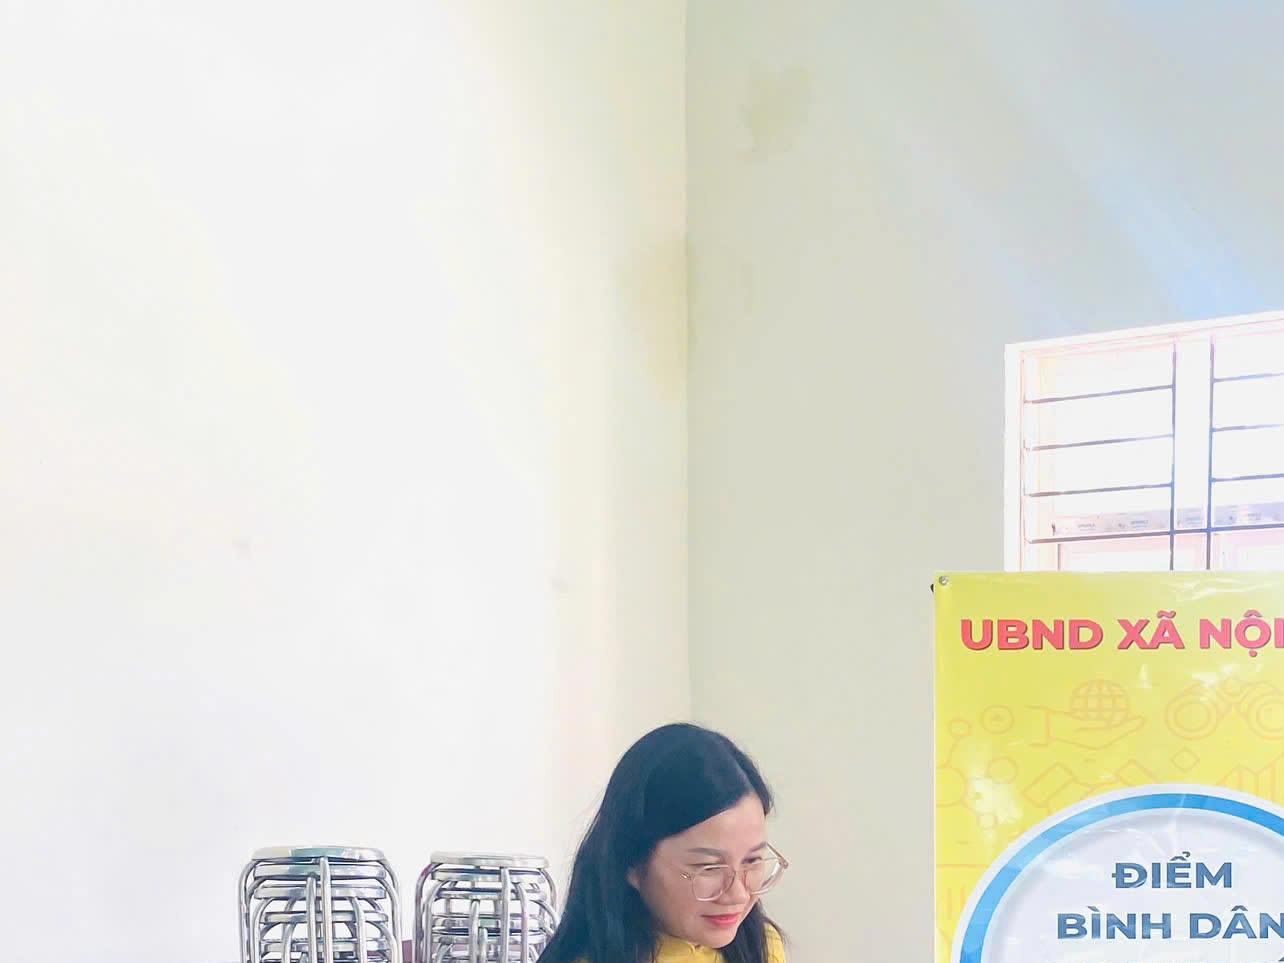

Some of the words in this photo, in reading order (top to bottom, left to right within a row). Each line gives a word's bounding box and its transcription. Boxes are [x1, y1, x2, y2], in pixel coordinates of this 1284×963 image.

[960, 617, 1103, 650] UBND
[1118, 610, 1185, 650] XÃ
[1111, 851, 1232, 889] ĐIỂM
[1057, 905, 1172, 940] BÌNH
